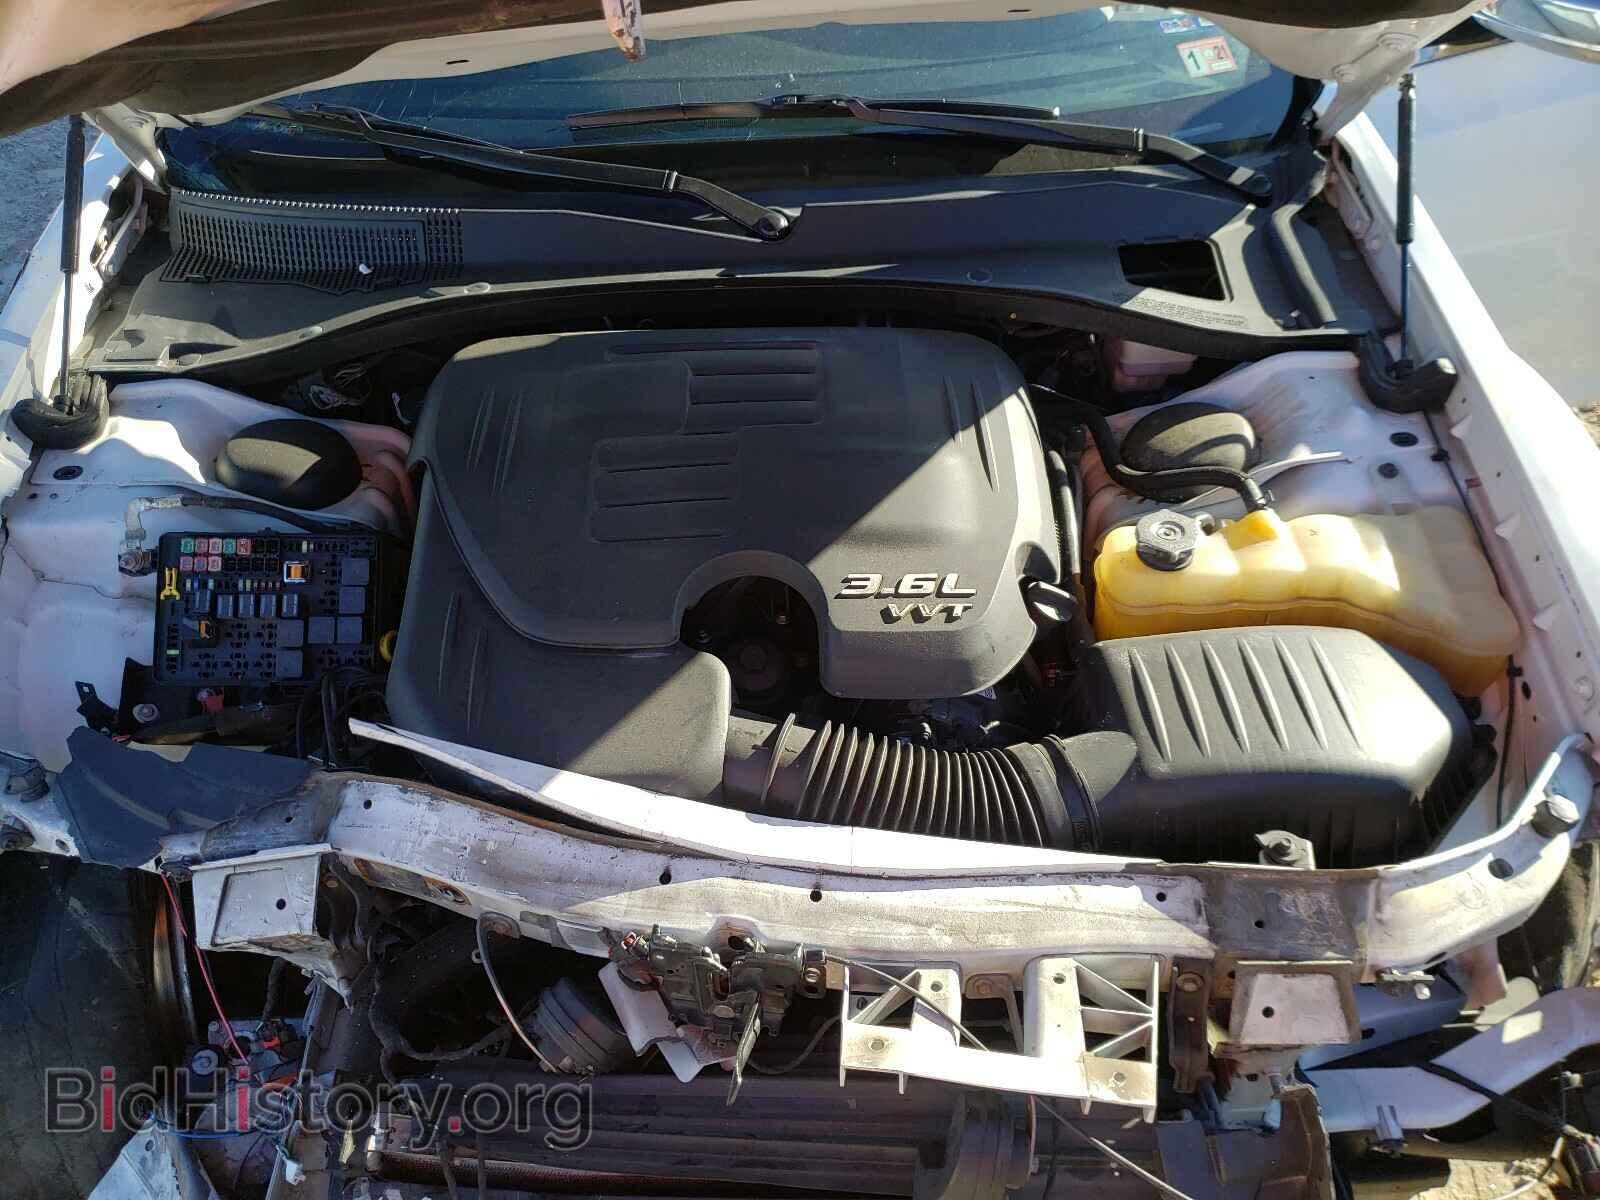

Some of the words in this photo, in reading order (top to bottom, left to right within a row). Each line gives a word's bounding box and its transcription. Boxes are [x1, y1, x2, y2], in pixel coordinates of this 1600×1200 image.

[1186, 50, 1201, 71] 1
[835, 572, 977, 599] 3.6L
[880, 603, 974, 624] VVT
